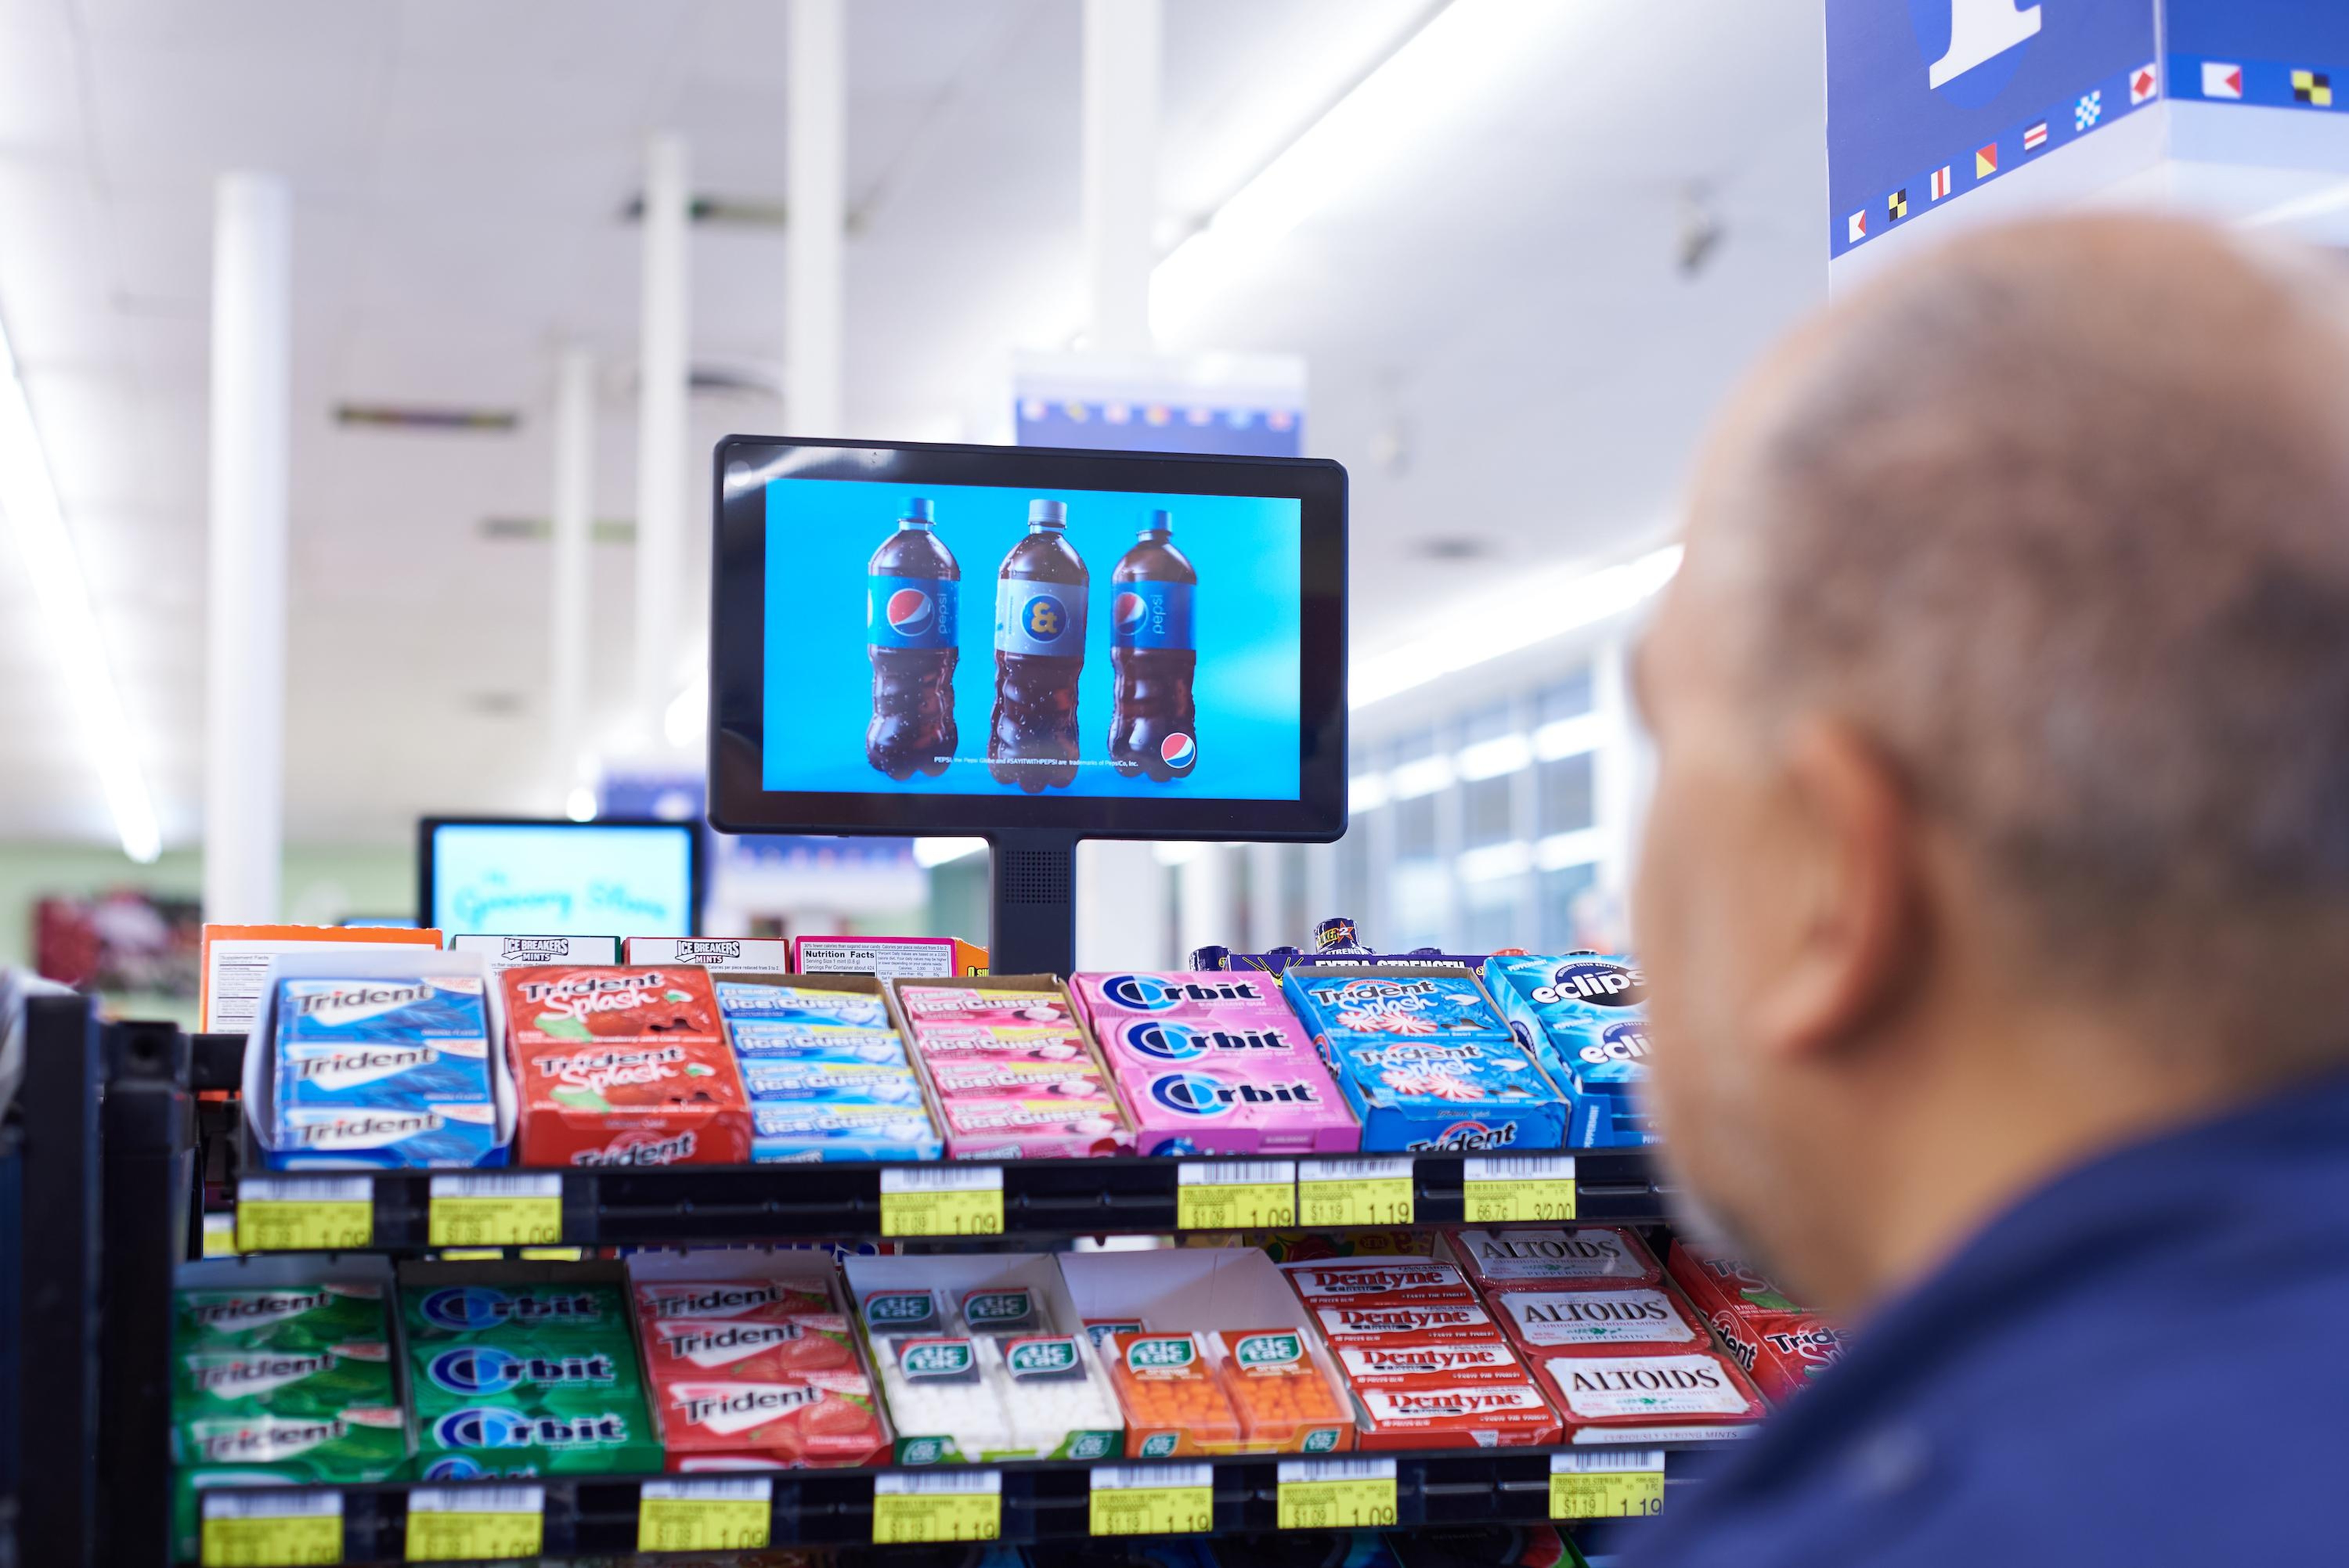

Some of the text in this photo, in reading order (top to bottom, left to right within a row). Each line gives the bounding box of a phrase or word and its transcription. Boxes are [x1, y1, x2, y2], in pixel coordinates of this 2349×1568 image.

[1150, 594, 1166, 635] pepsi
[1339, 927, 1350, 936] 2
[504, 938, 568, 955] ICE BREAKERS
[677, 941, 739, 957] ICE BREAKERS
[294, 984, 434, 1014] Trident
[521, 973, 662, 1000] Trident
[1102, 975, 1263, 1011] Orbit
[1311, 980, 1436, 1004] Trident
[1532, 968, 1646, 1004] eclips
[544, 983, 658, 1022] Splash
[1338, 994, 1438, 1022] Splash
[1127, 1021, 1290, 1061] Orbit
[1356, 1045, 1480, 1064] Trident
[296, 1048, 435, 1078] Trident
[534, 1047, 683, 1075] Trident
[1381, 1058, 1485, 1083] Splash
[559, 1060, 679, 1095] Splash
[1151, 1073, 1320, 1116] Orbit
[296, 1113, 440, 1145] Trident
[1482, 1240, 1621, 1259] ALTOIDS
[1314, 1271, 1444, 1288] Dentyne
[191, 1291, 331, 1323] Trident
[422, 1288, 601, 1330] Orbit
[647, 1286, 783, 1317] Trident
[878, 1307, 922, 1317] tac
[887, 1297, 923, 1308] tic
[1525, 1301, 1668, 1323] ALTOIDS
[1340, 1310, 1470, 1326] Dentyne
[660, 1325, 802, 1357] Trident
[1147, 1341, 1183, 1354] tic
[1246, 1348, 1290, 1360] tac
[1254, 1338, 1290, 1351] tic
[192, 1353, 336, 1389] Trident
[431, 1348, 614, 1393] Orbit
[1138, 1351, 1183, 1363] tac
[1364, 1351, 1495, 1367] Dentyne
[1573, 1368, 1720, 1392] ALTOIDS
[675, 1386, 822, 1423] Trident
[1388, 1394, 1523, 1409] Dentyne
[200, 1417, 347, 1456] Trident
[436, 1409, 626, 1447] Orbit
